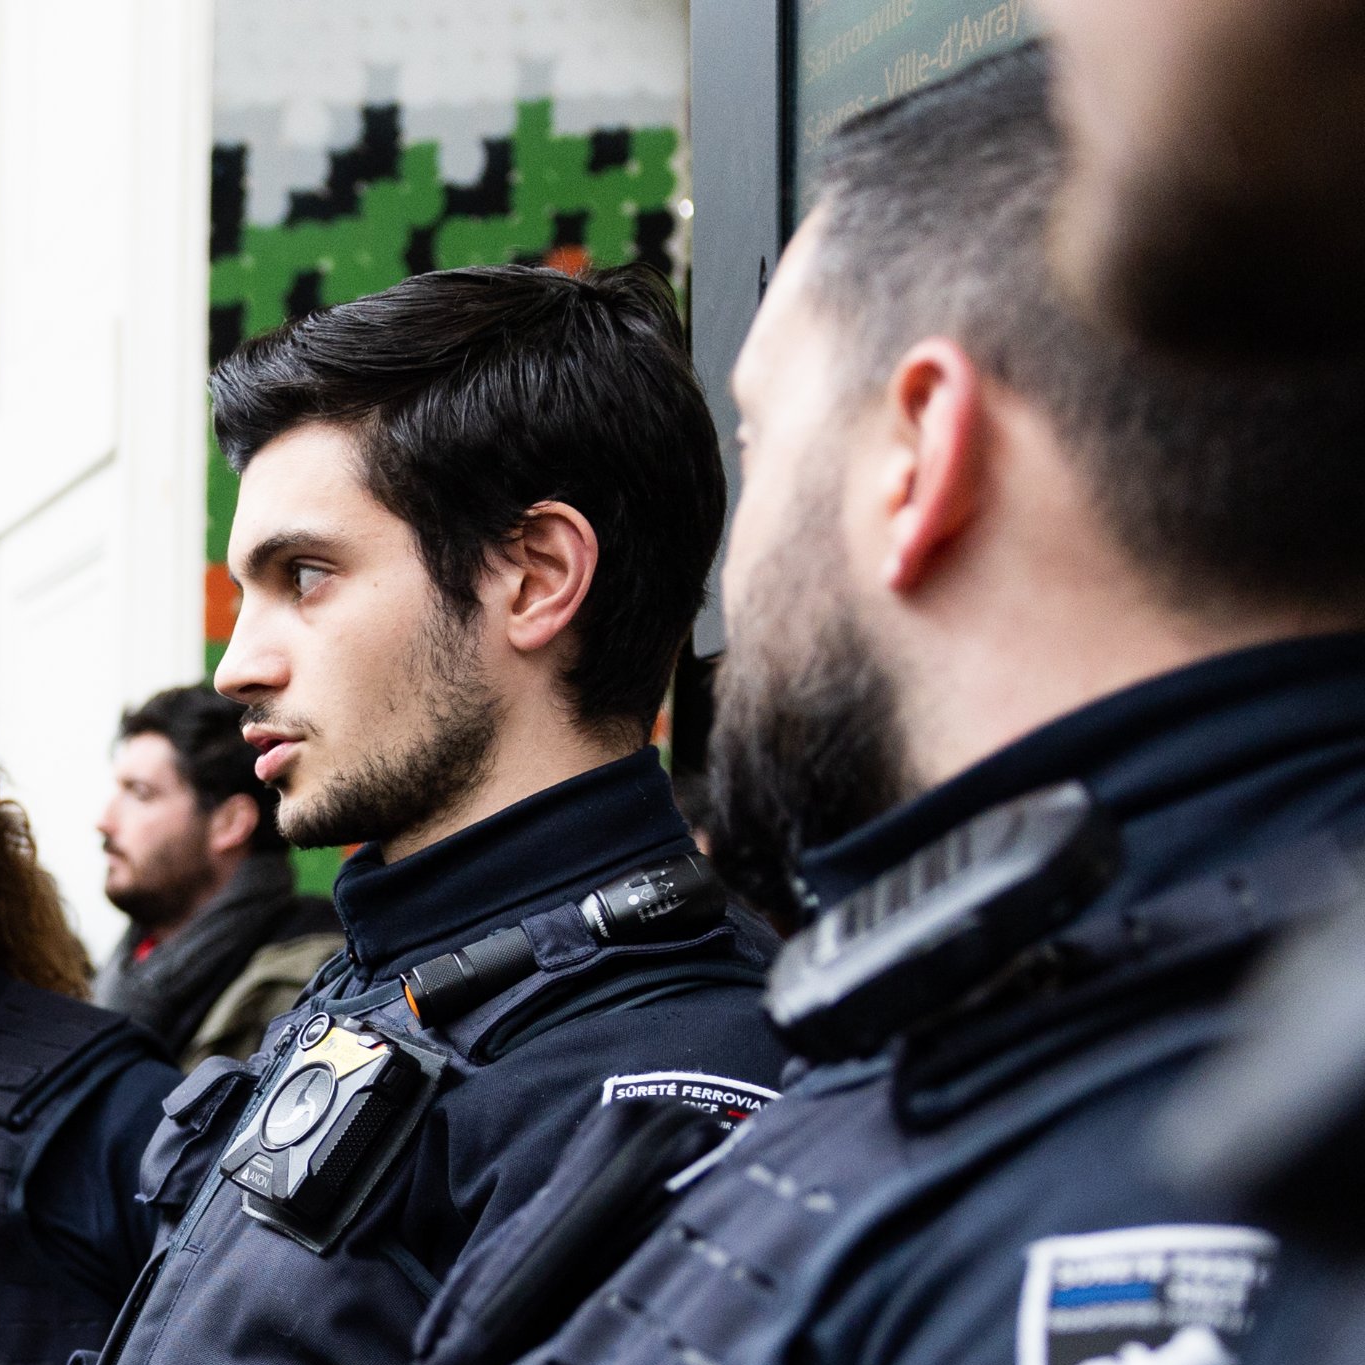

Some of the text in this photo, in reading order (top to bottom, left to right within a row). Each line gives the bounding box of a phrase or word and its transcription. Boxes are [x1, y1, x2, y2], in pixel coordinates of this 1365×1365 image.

[884, 0, 1019, 100] Ville-d'Avray
[615, 1082, 677, 1099] SÛRETÉ
[249, 1170, 270, 1189] AXON
